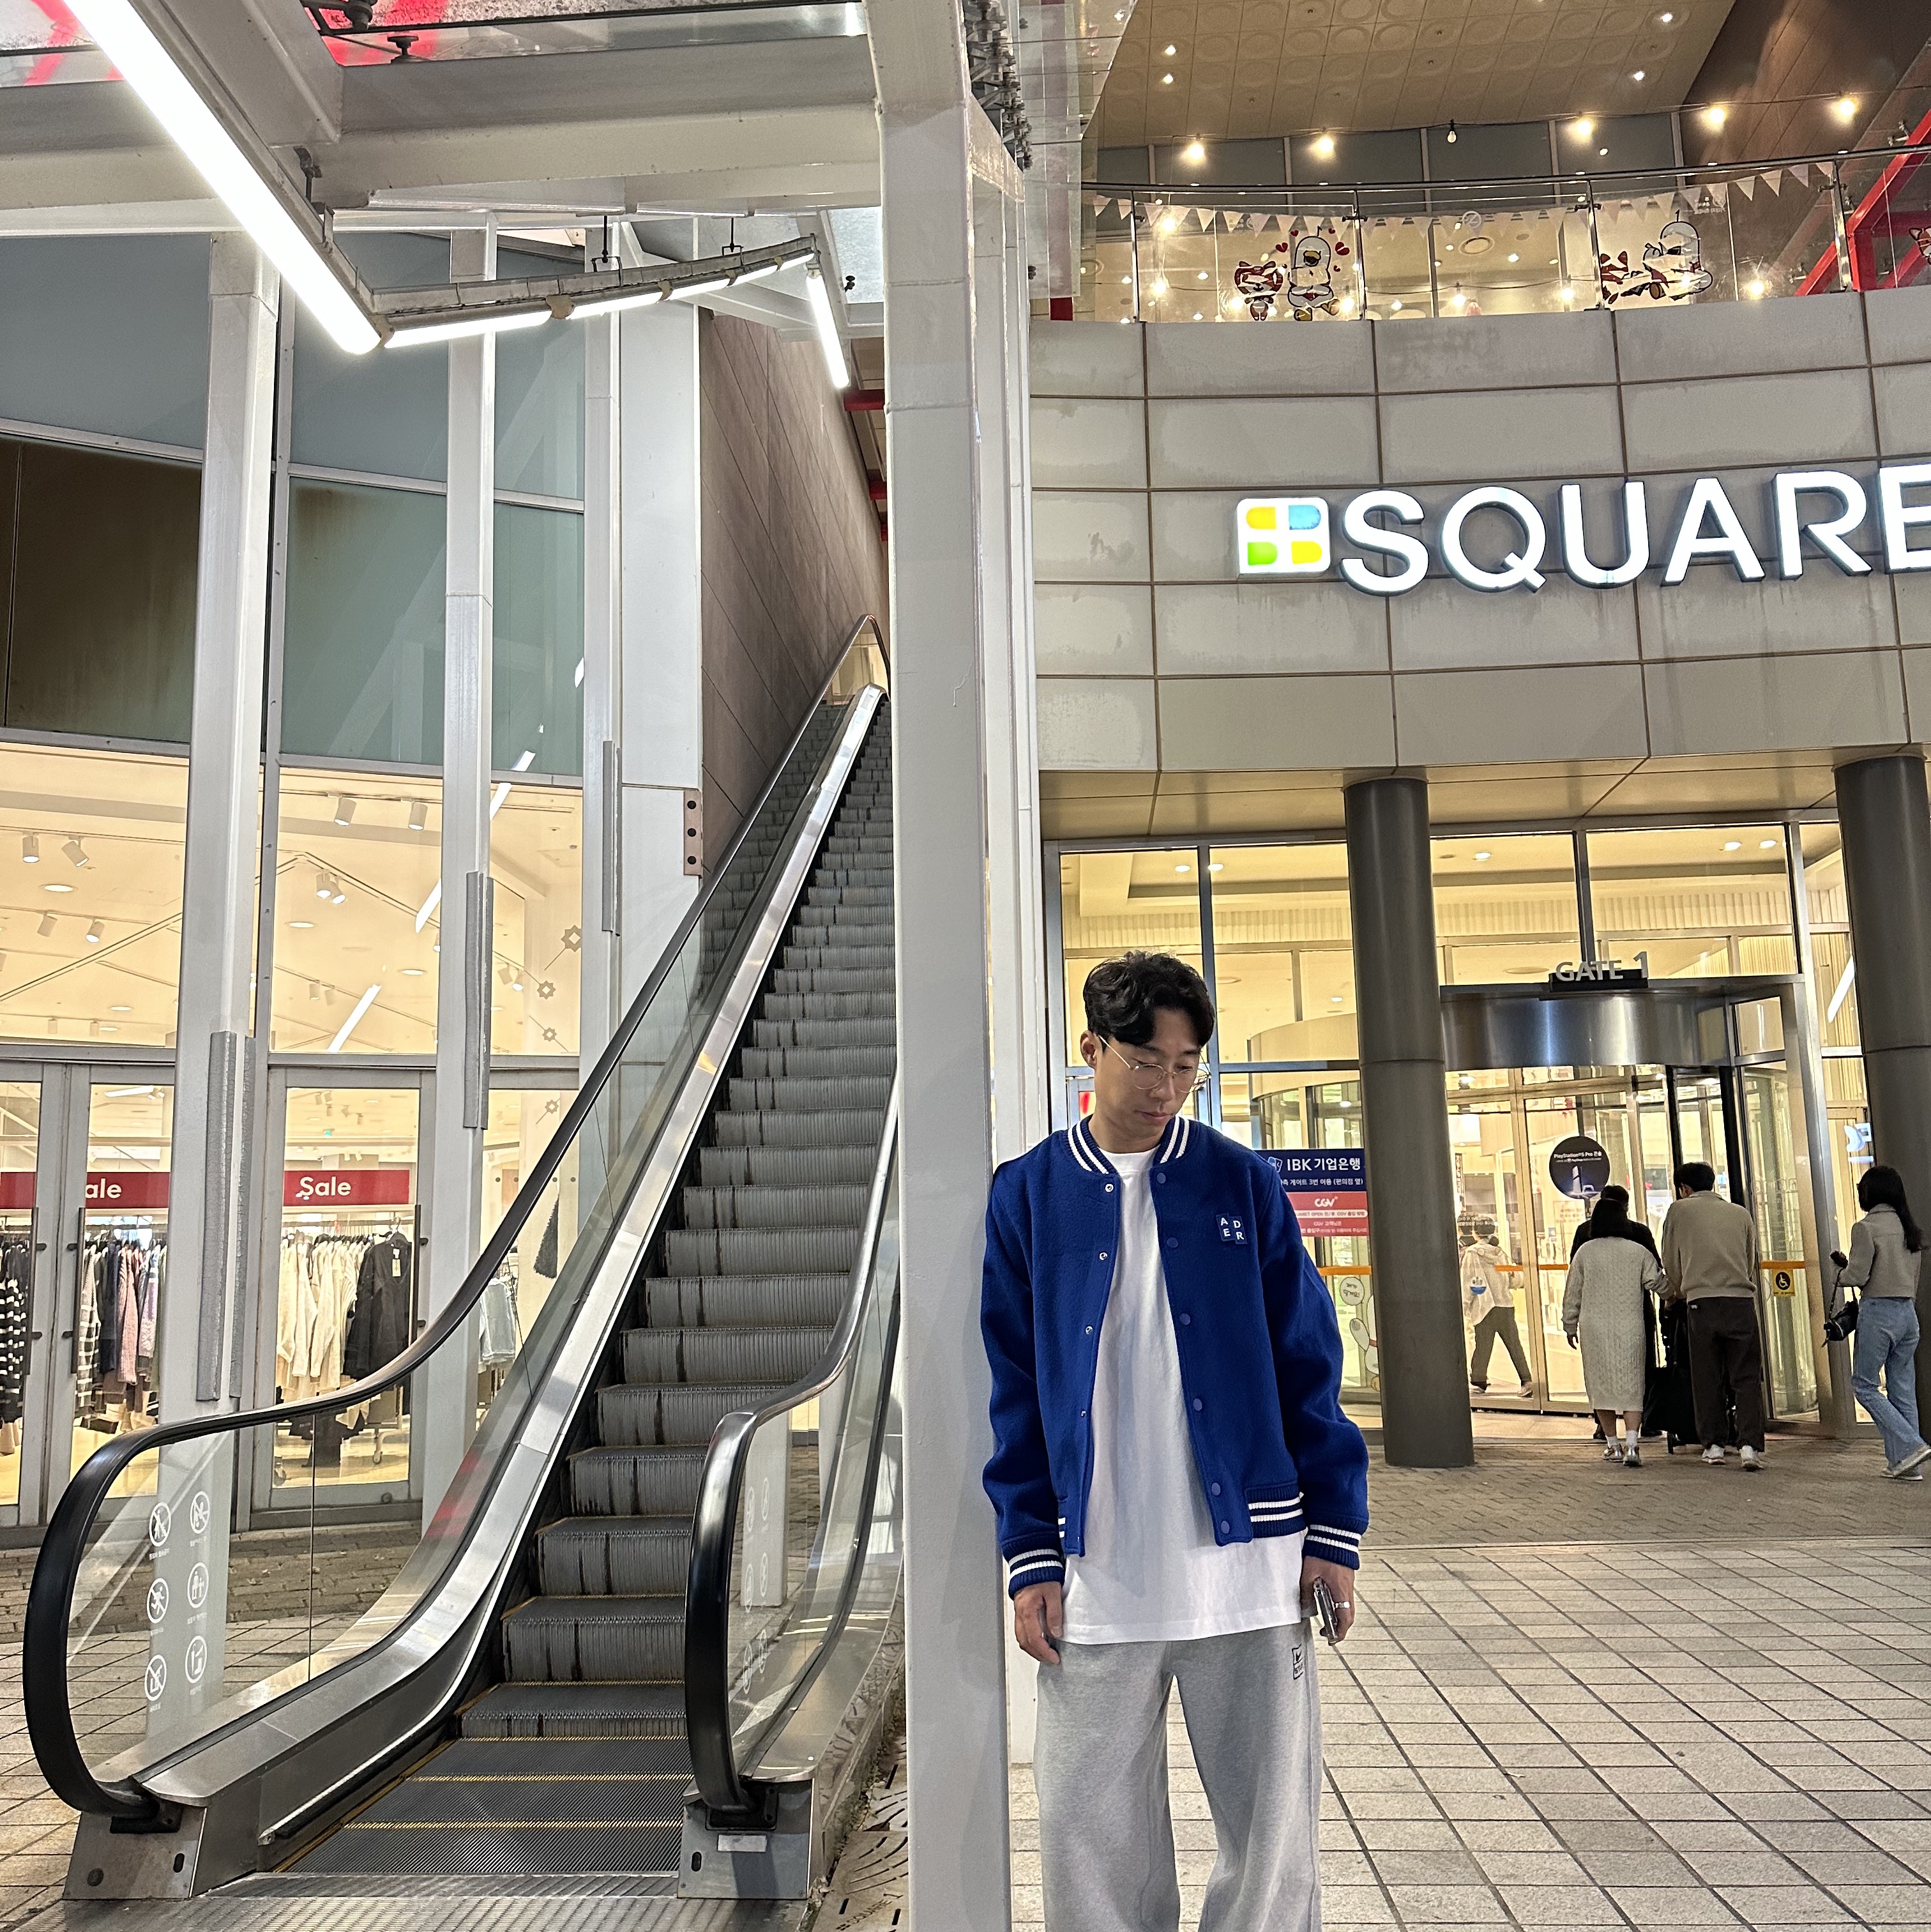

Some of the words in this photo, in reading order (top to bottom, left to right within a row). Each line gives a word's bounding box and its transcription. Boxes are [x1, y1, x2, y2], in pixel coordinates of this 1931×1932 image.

[1340, 464, 1931, 595] SQUARE
[1556, 960, 1624, 982] GATE
[1633, 951, 1649, 978] 1
[1287, 1159, 1312, 1171] IBK
[1314, 1157, 1361, 1171] 기업은행
[85, 1178, 122, 1199] ale
[299, 1176, 351, 1196] Sale
[1314, 1198, 1336, 1208] CGV
